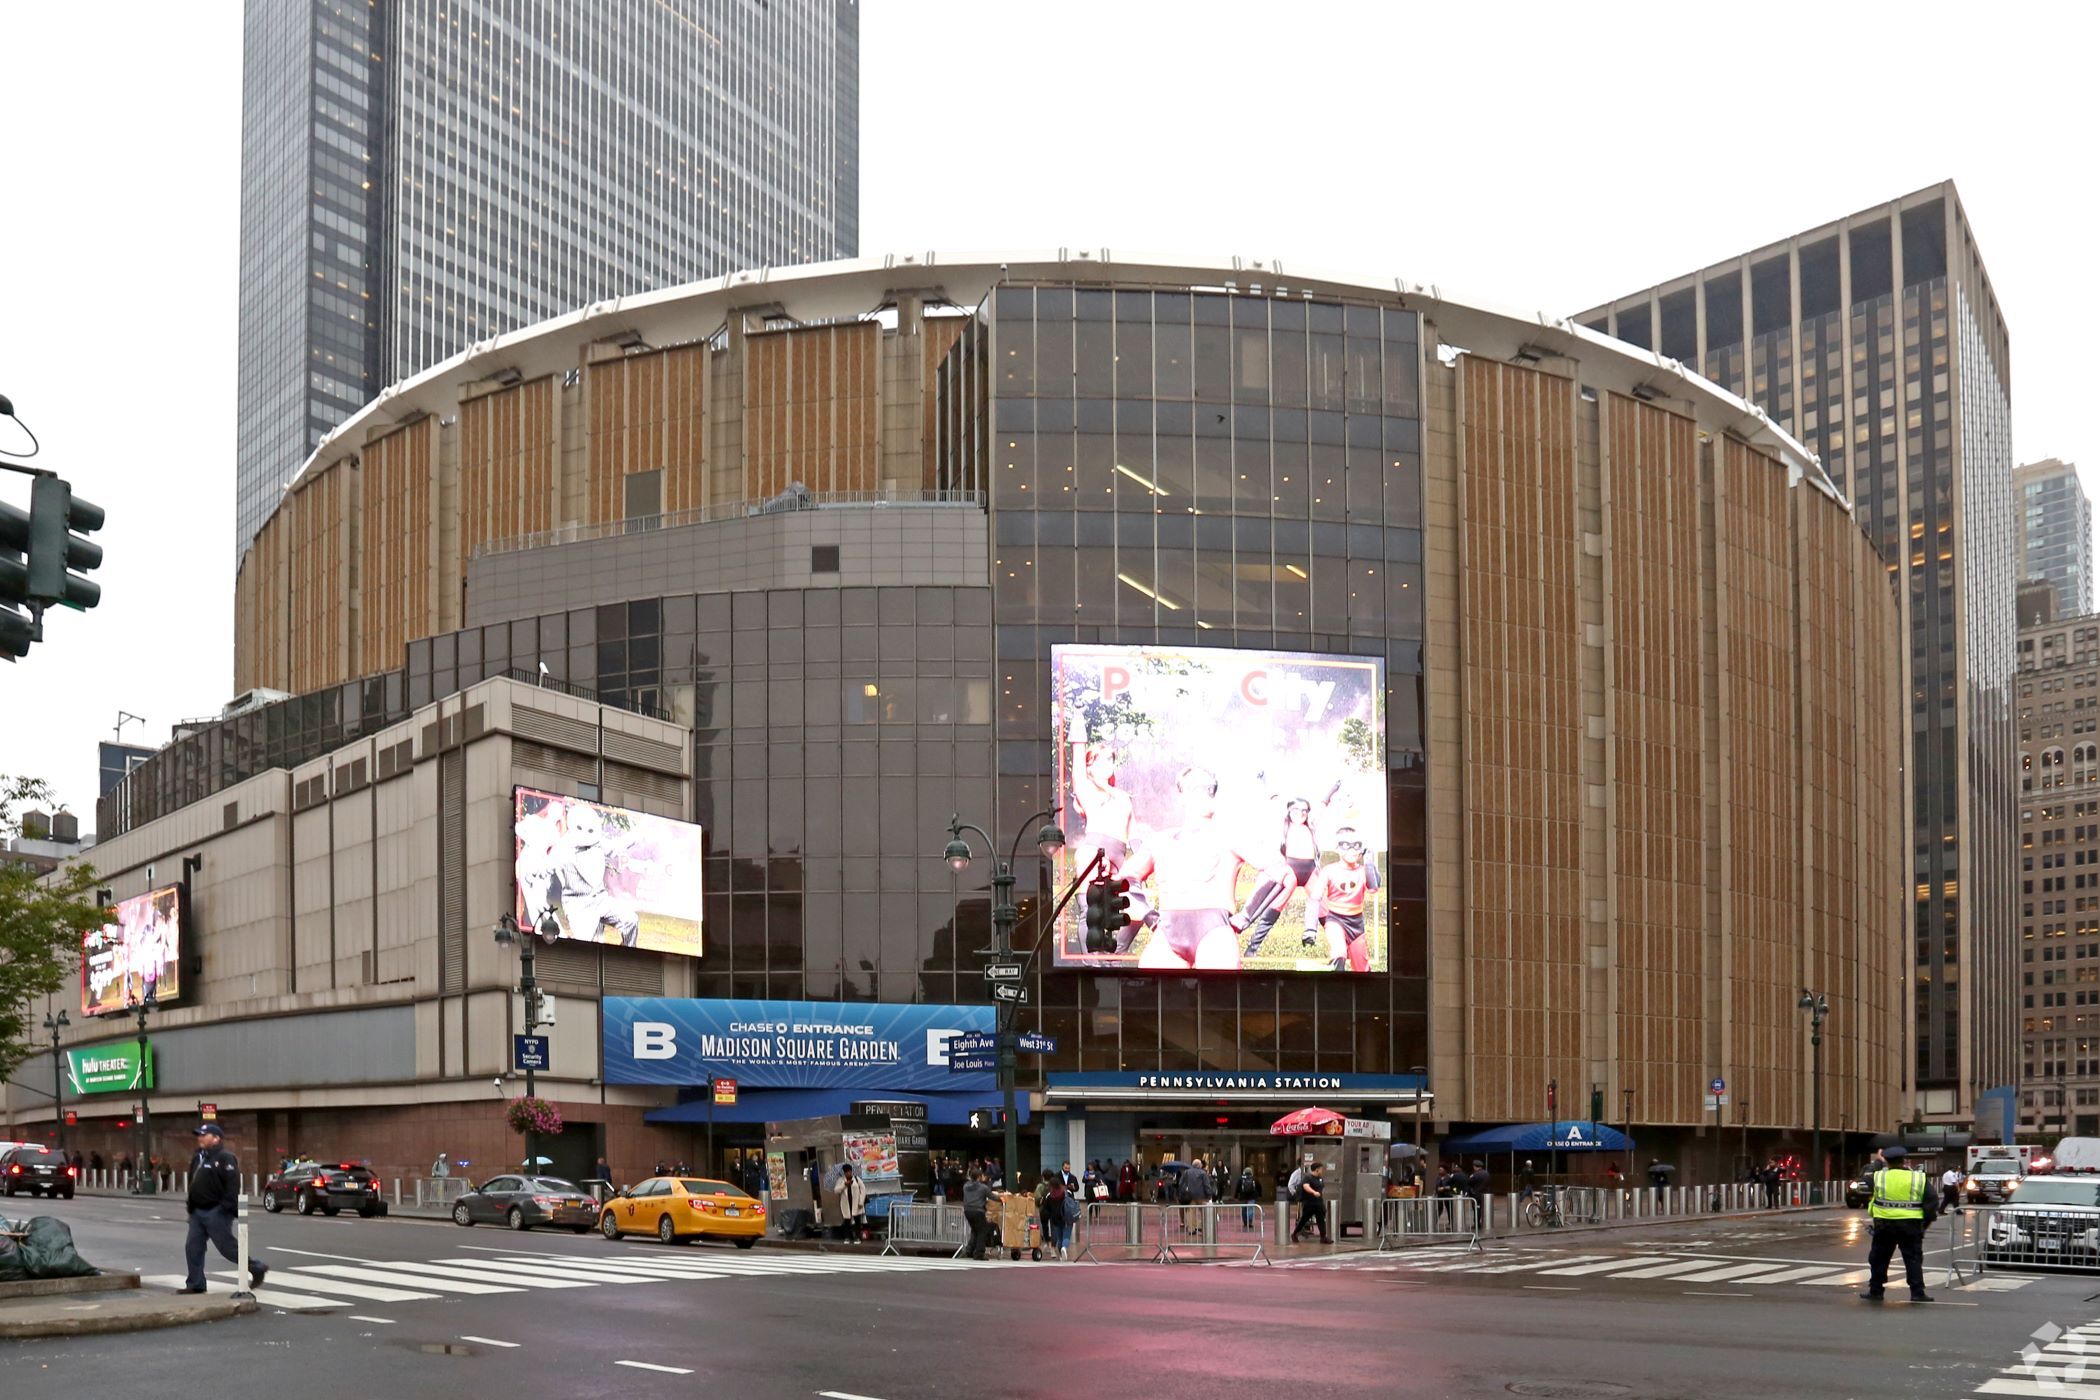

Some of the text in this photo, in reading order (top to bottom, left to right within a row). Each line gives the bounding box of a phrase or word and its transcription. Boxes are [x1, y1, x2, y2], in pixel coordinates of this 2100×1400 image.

[729, 1022, 874, 1035] CHASE ENTRANCE
[633, 1021, 677, 1060] B
[701, 1034, 771, 1058] MADISON
[776, 1035, 835, 1060] SQUARE
[954, 1039, 994, 1051] Eighth Ave
[1019, 1037, 1036, 1049] West
[1047, 1042, 1054, 1051] St
[82, 1057, 127, 1074] hulu THEATER
[953, 1060, 965, 1070] Joe
[965, 1058, 983, 1069] Louis
[1139, 1076, 1342, 1088] PENNSYLVANIA STATION
[893, 1104, 924, 1117] STATION
[1567, 1126, 1582, 1139] A
